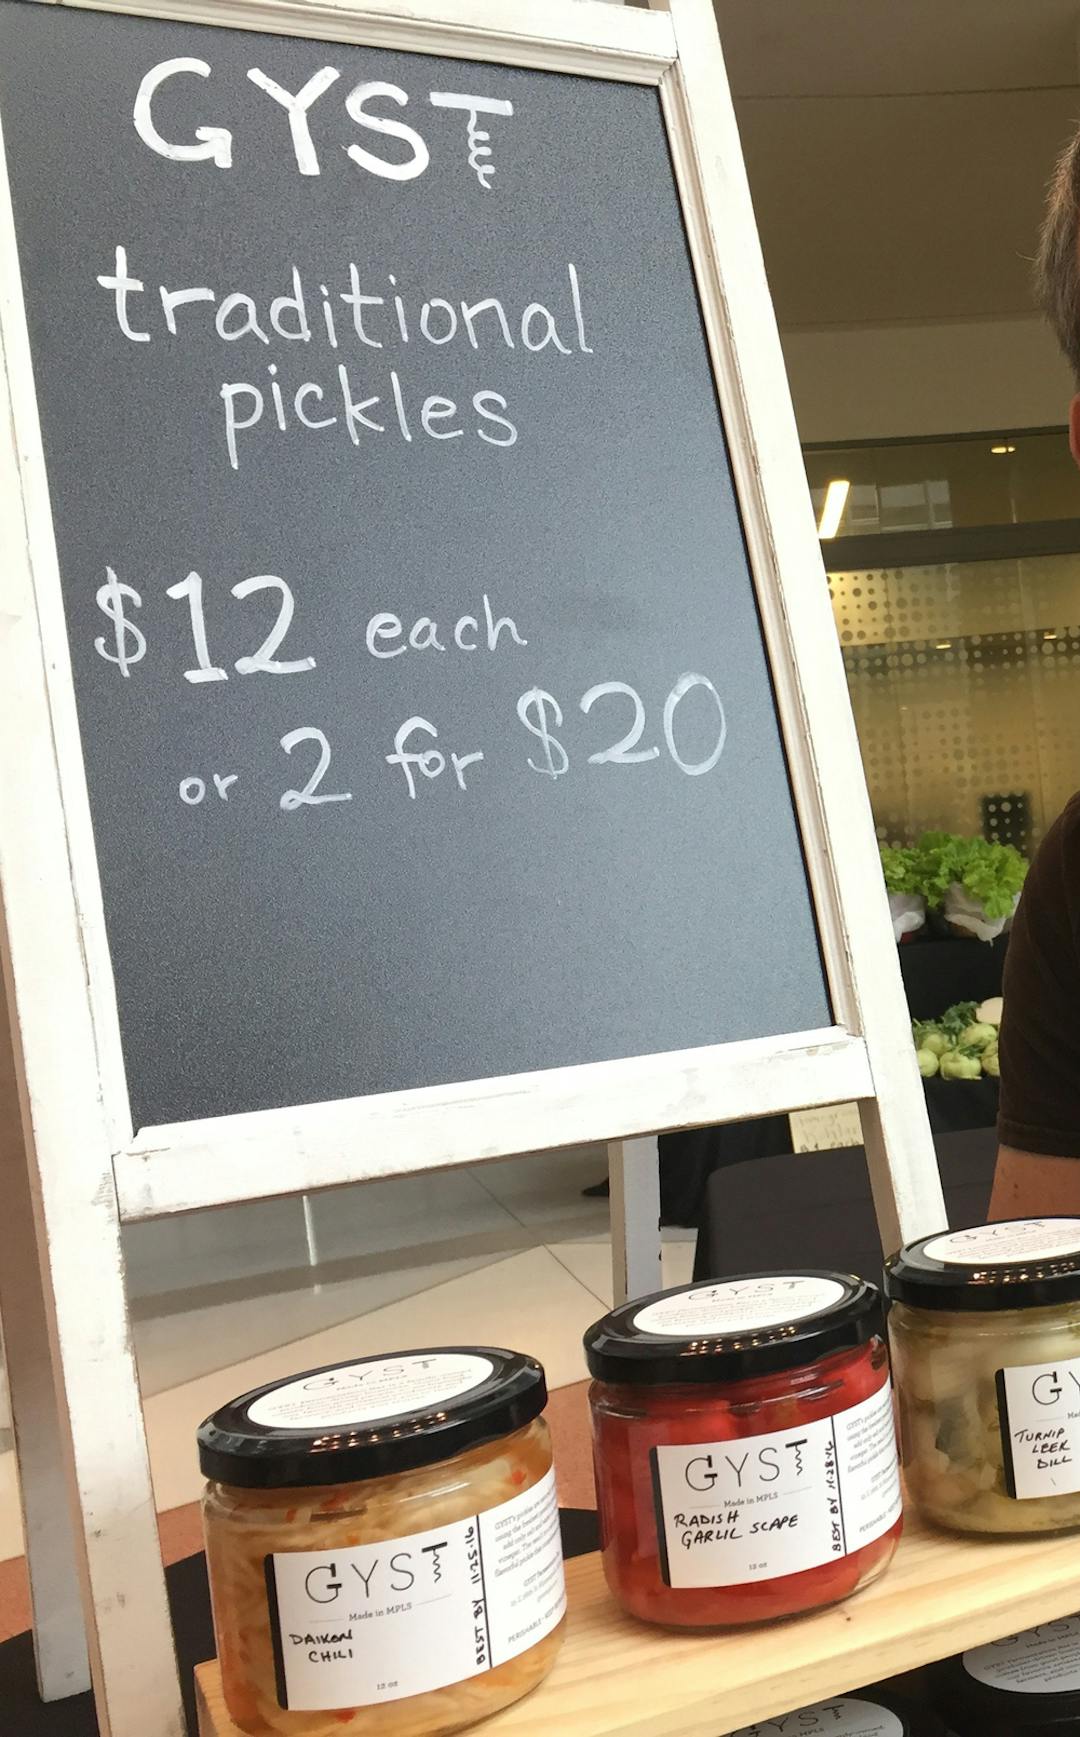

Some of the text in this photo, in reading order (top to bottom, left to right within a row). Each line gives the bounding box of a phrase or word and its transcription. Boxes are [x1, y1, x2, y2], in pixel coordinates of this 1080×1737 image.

[133, 56, 513, 189] GYST
[97, 245, 593, 355] traditional
[220, 364, 519, 469] pickles
[94, 566, 528, 684] $12 each
[179, 671, 727, 811] or 2 for $20
[303, 1358, 437, 1391] GYST
[1014, 1427, 1065, 1444] TURNIP
[685, 1438, 808, 1492] GYST
[1036, 1455, 1072, 1470] DILL
[723, 1491, 779, 1508] Made in MPLS
[826, 1496, 839, 1515] BY
[673, 1509, 740, 1528] RADISH
[749, 1514, 799, 1534] SCAPE
[831, 1520, 841, 1552] BEST
[305, 1541, 448, 1604] GYST
[348, 1602, 413, 1622] Made in MPLS
[472, 1598, 486, 1619] BY
[308, 1648, 353, 1663] CHILI
[474, 1625, 486, 1665] BEST
